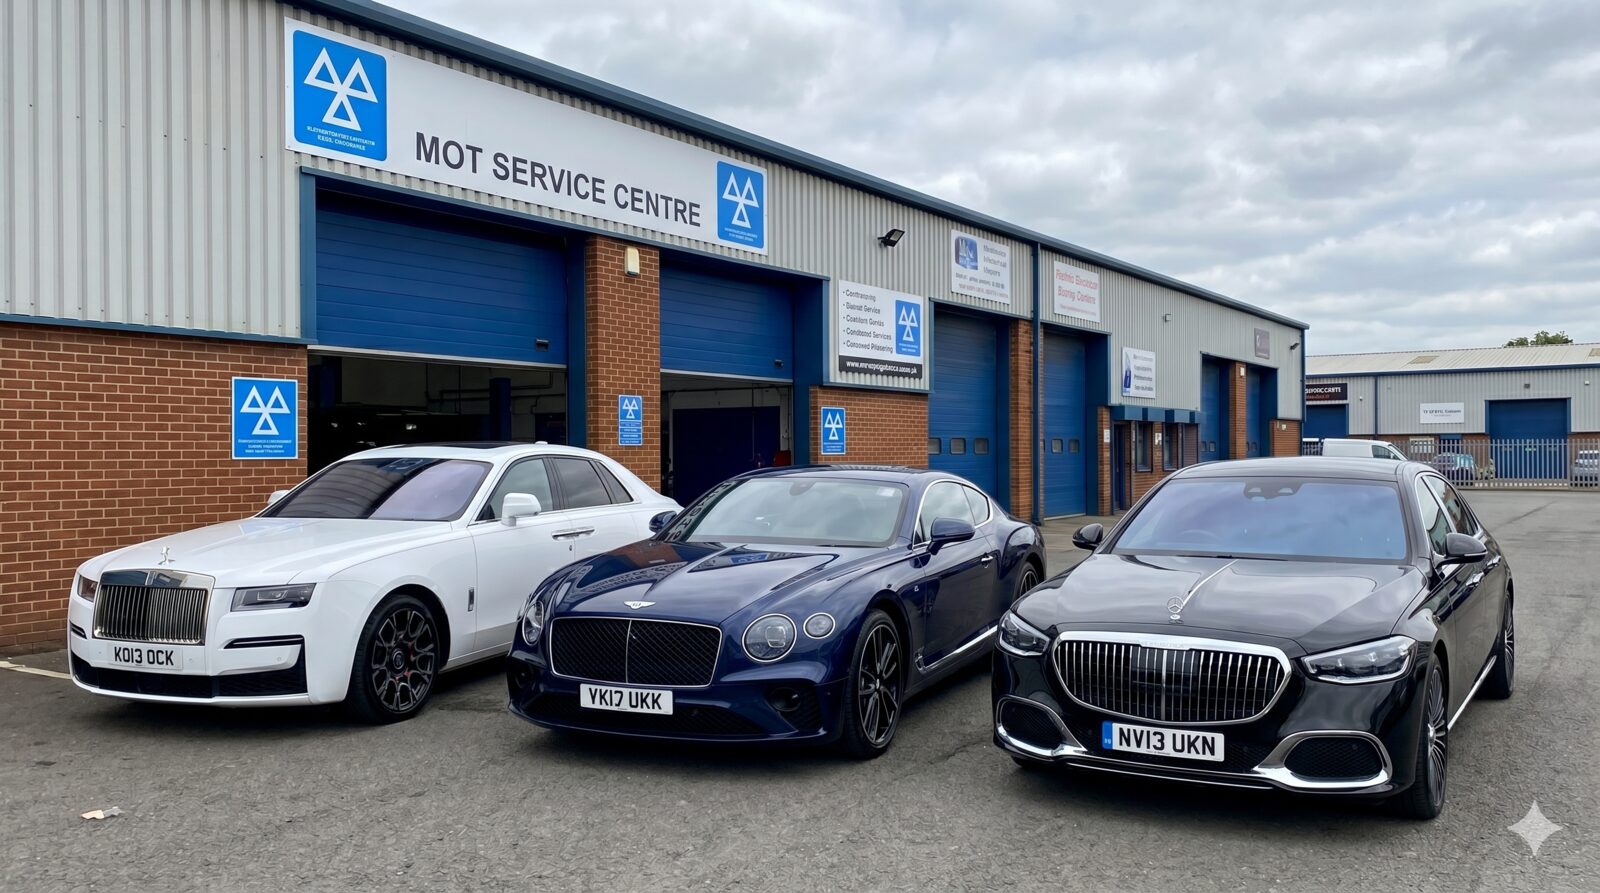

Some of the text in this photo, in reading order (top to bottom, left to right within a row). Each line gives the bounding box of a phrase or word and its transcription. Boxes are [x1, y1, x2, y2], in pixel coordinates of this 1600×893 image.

[416, 131, 483, 174] MOT
[492, 152, 606, 205] SERVICE
[613, 183, 701, 228] CENTRE
[146, 649, 174, 666] OCK
[588, 687, 662, 711] YK17 UKK
[1118, 726, 1216, 757] NV13 UKN
